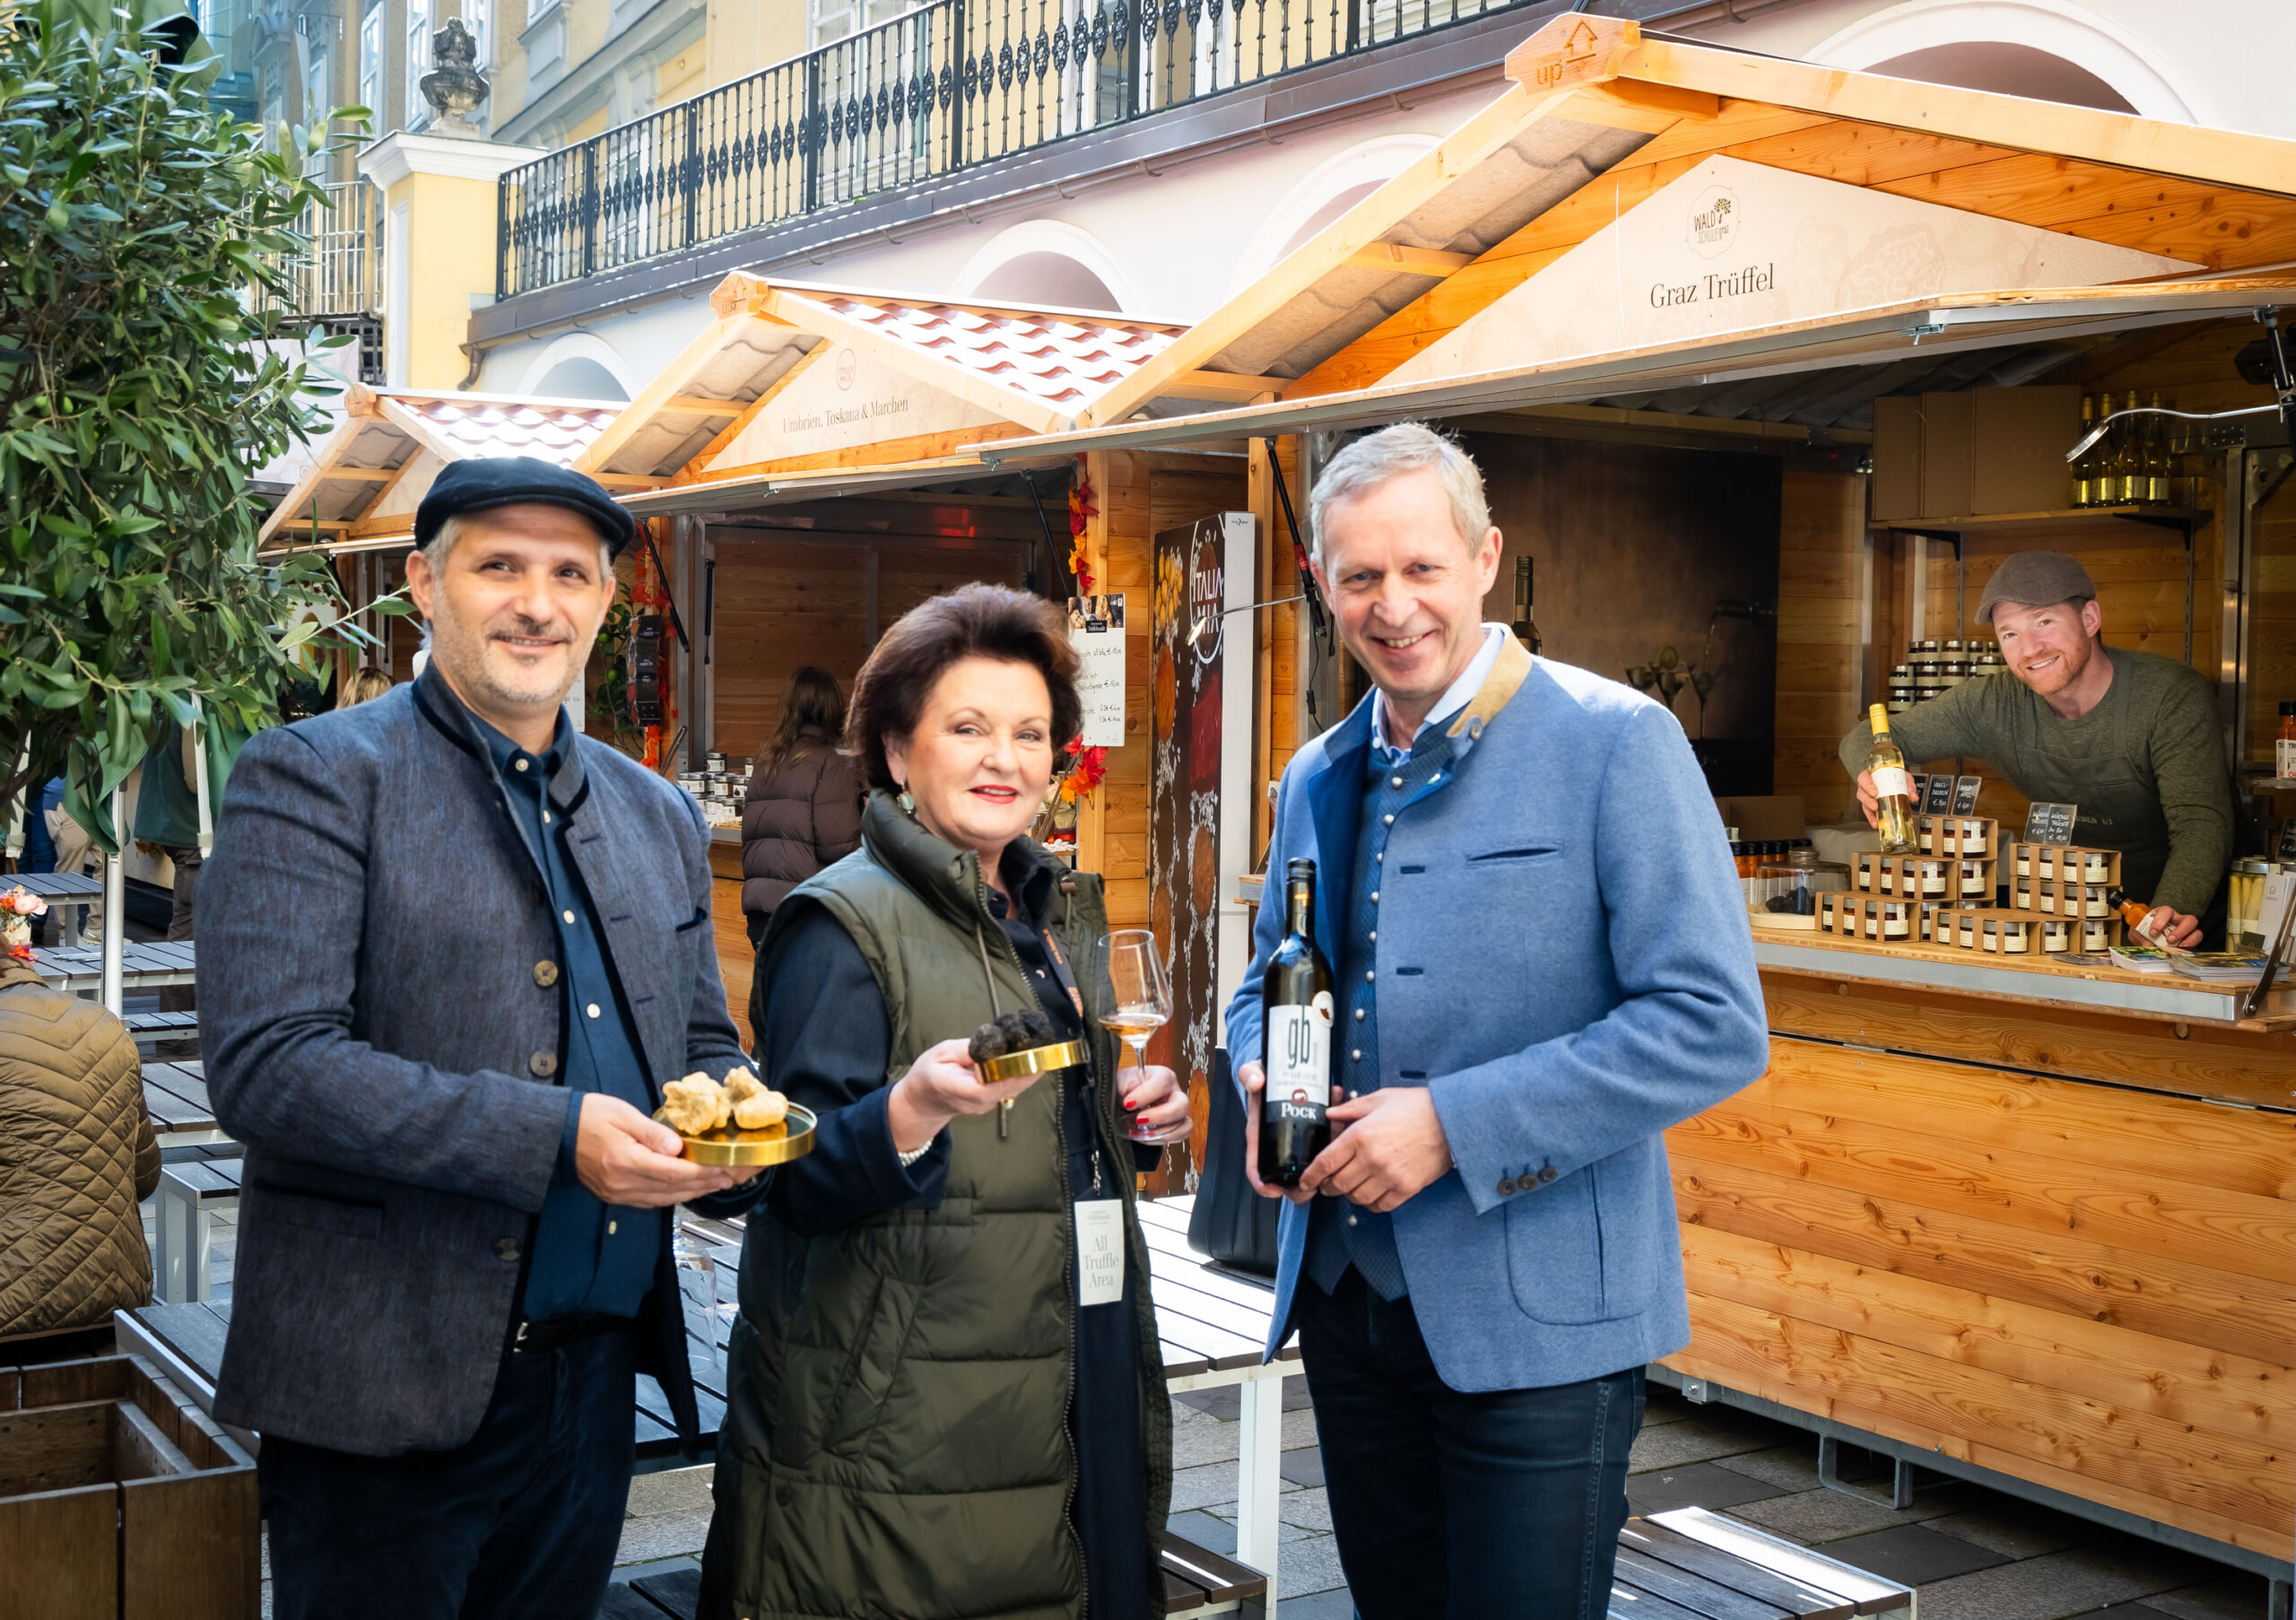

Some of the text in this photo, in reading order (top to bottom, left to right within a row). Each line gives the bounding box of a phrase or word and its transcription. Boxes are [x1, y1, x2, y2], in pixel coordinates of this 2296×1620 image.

[1693, 210, 1716, 231] WALD
[1698, 224, 1729, 244] SCHULE graz
[1650, 262, 1775, 309] Graz Trüffel
[839, 374, 852, 384] MIA
[825, 407, 860, 426] Toskana
[861, 401, 868, 419] &
[870, 396, 909, 418] Marchen
[1193, 566, 1224, 603] ITALIA
[1093, 1234, 1108, 1252] All
[1083, 1251, 1119, 1270] Truffle
[1089, 1272, 1114, 1289] Area
